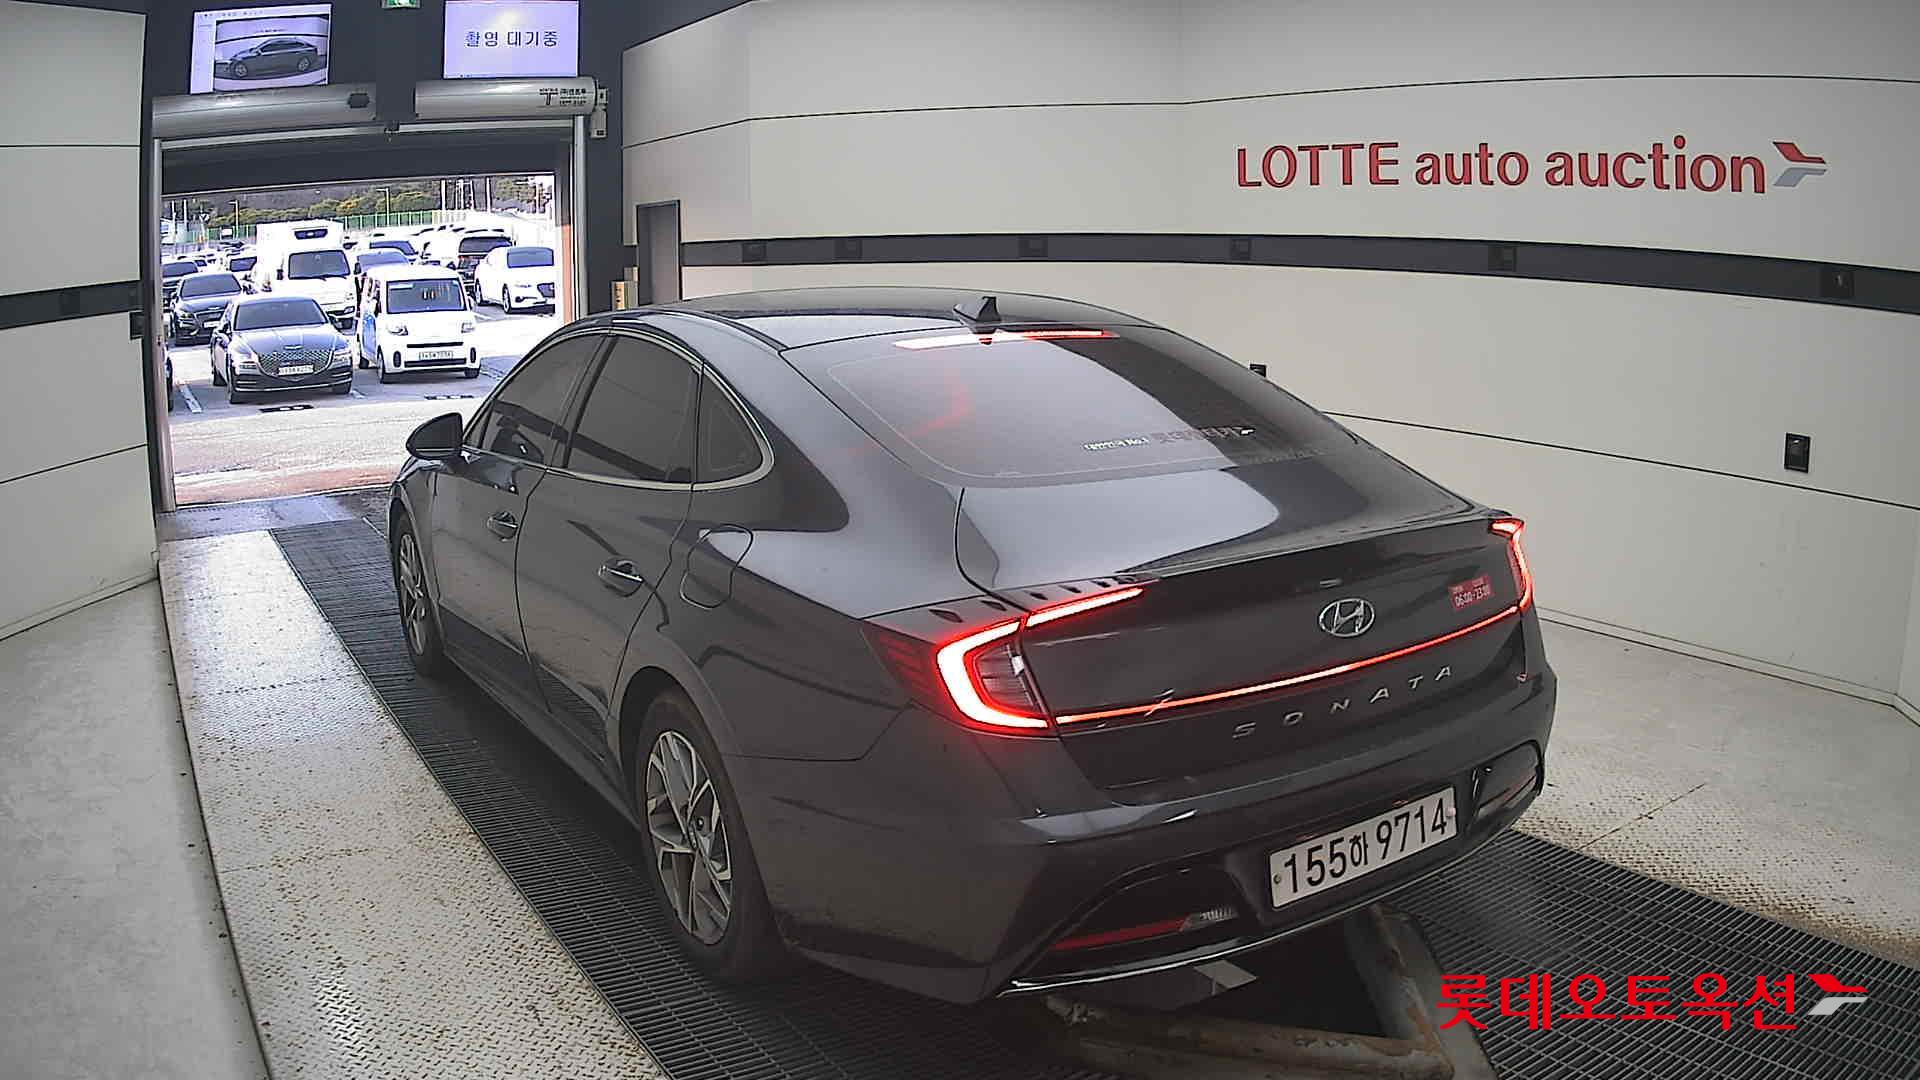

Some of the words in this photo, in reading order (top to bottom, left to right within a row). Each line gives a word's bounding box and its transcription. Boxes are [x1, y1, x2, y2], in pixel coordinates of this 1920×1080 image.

[507, 31, 559, 47] 대기중
[1236, 141, 1400, 188] LOTTE
[1415, 141, 1529, 188] auto
[1544, 134, 1767, 194] auction
[1232, 665, 1452, 738] SONATA
[1284, 831, 1369, 894] 155하
[1376, 798, 1449, 860] 9714
